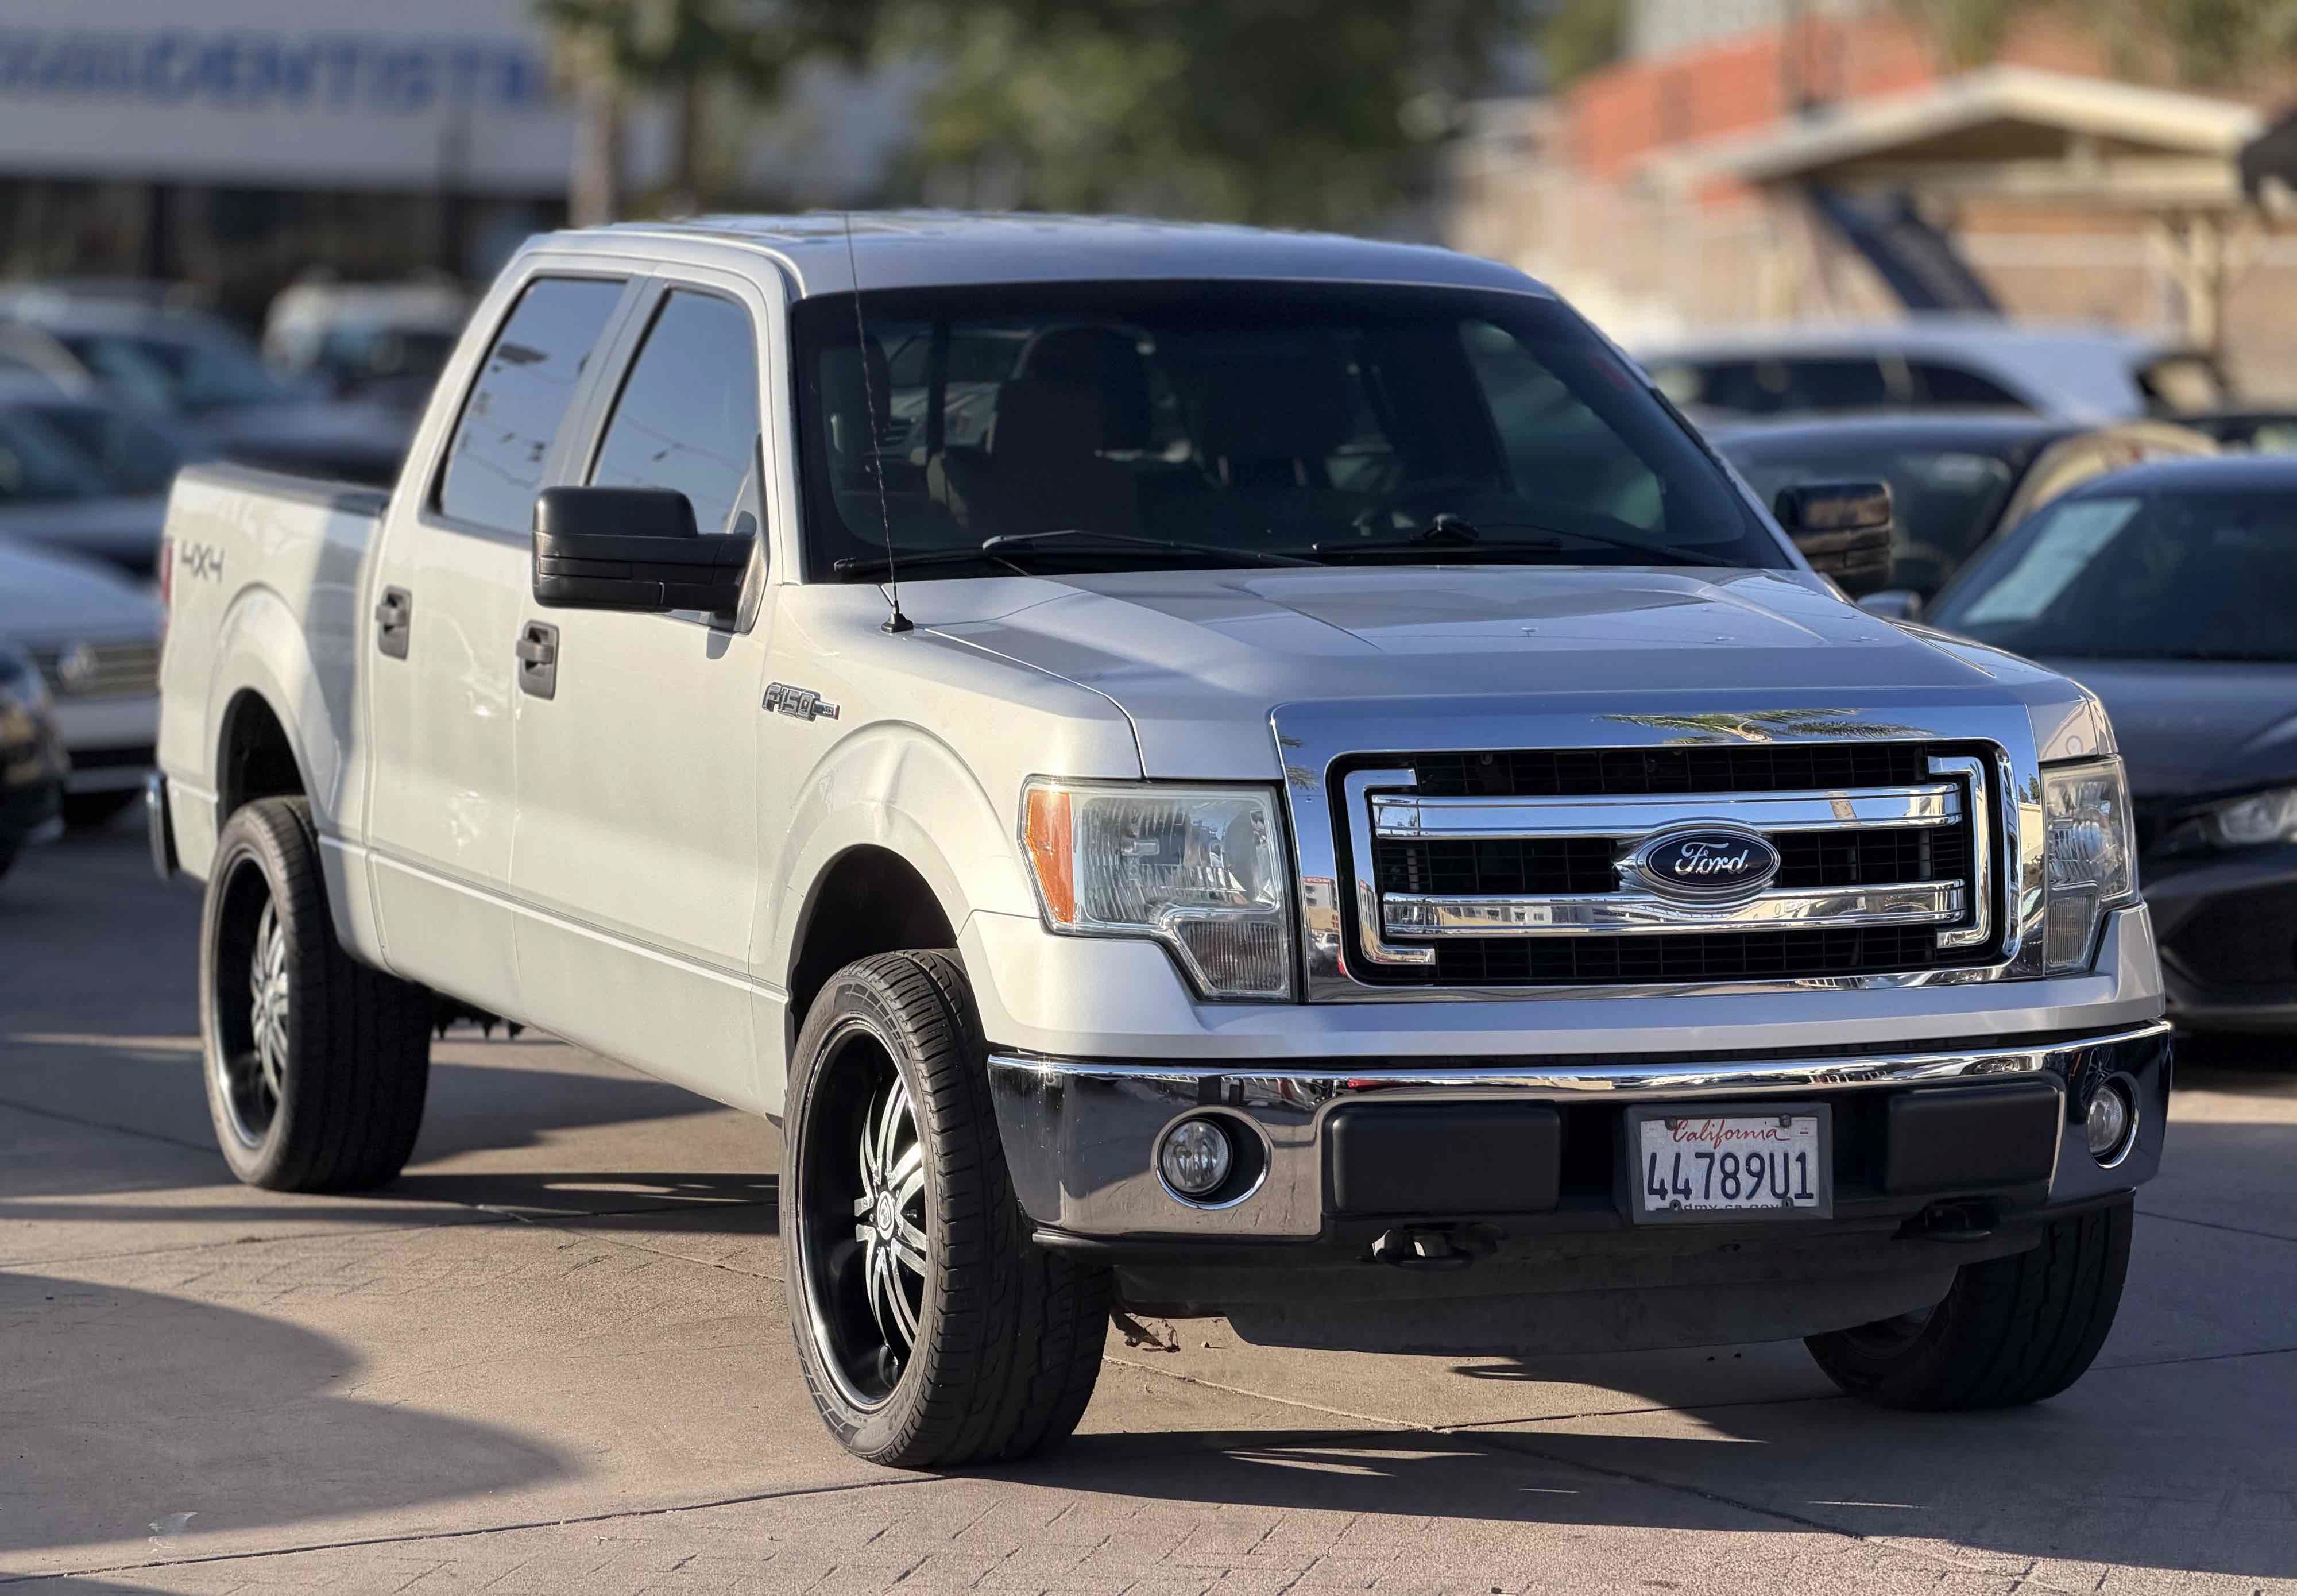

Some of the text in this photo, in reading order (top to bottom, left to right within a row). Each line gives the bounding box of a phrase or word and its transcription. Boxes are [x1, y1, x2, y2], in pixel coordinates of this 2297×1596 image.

[1675, 841, 1749, 875] Ford
[1672, 1119, 1790, 1149] California
[1647, 1151, 1815, 1200] 44789U1
